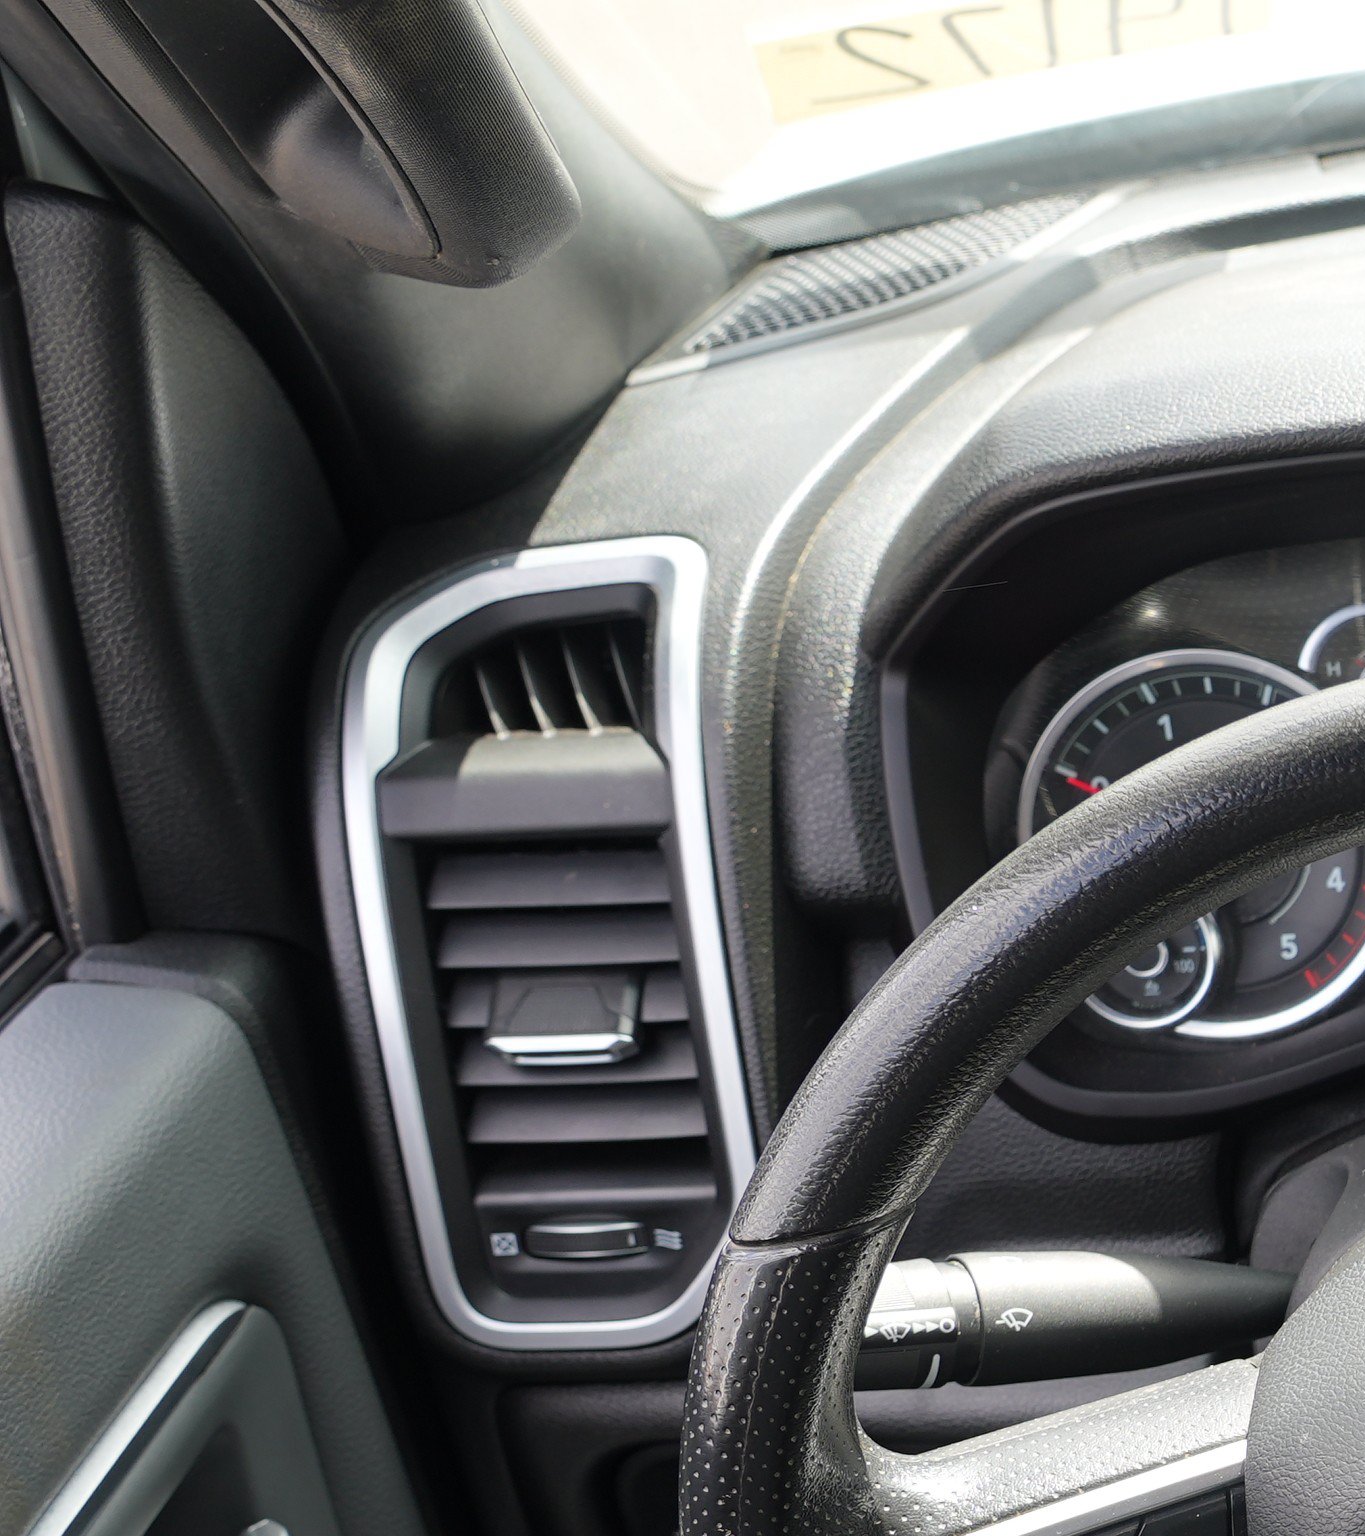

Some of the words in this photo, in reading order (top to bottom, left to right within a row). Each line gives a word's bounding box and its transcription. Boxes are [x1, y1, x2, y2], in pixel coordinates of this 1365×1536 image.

[1325, 660, 1342, 678] H
[1156, 713, 1174, 741] 1
[1325, 865, 1346, 893] 4
[1280, 932, 1299, 961] 5
